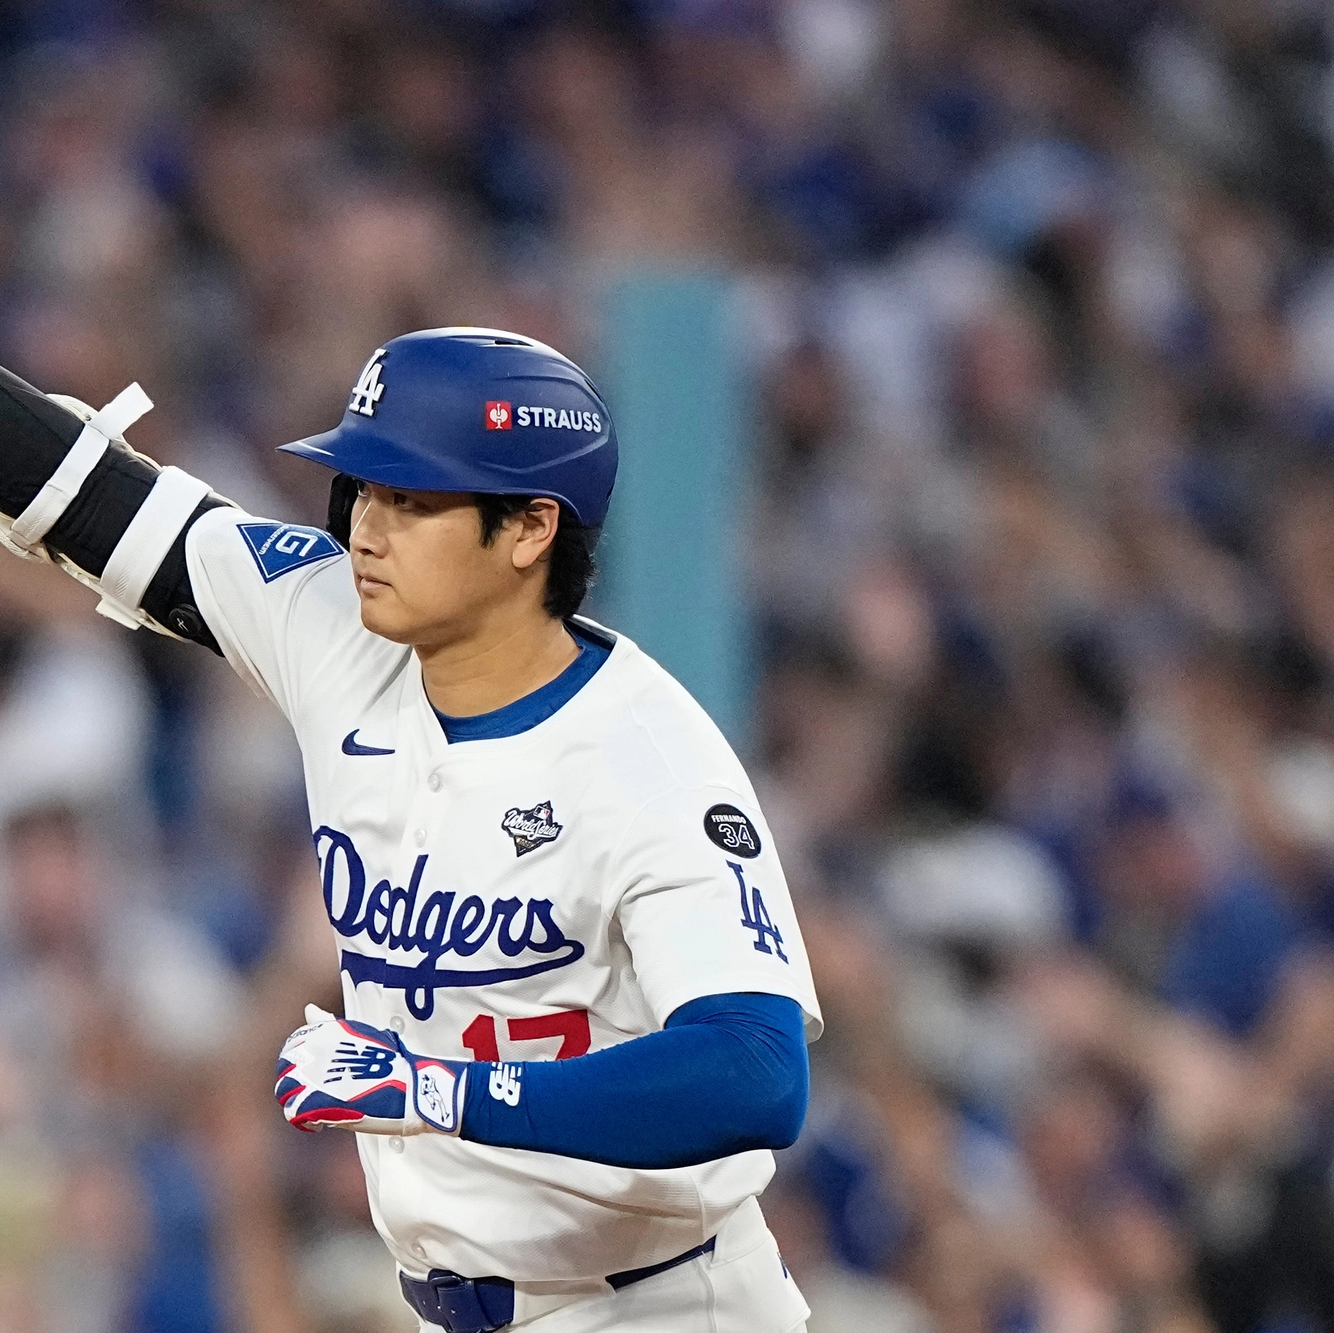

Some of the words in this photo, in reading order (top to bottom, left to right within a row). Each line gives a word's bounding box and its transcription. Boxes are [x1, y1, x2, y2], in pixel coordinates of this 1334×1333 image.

[348, 348, 388, 416] LA
[517, 406, 601, 433] STRAUSS
[711, 815, 747, 825] FERNANDO
[718, 823, 755, 850] 34
[313, 825, 584, 1021] Dodgers
[725, 859, 789, 965] LA
